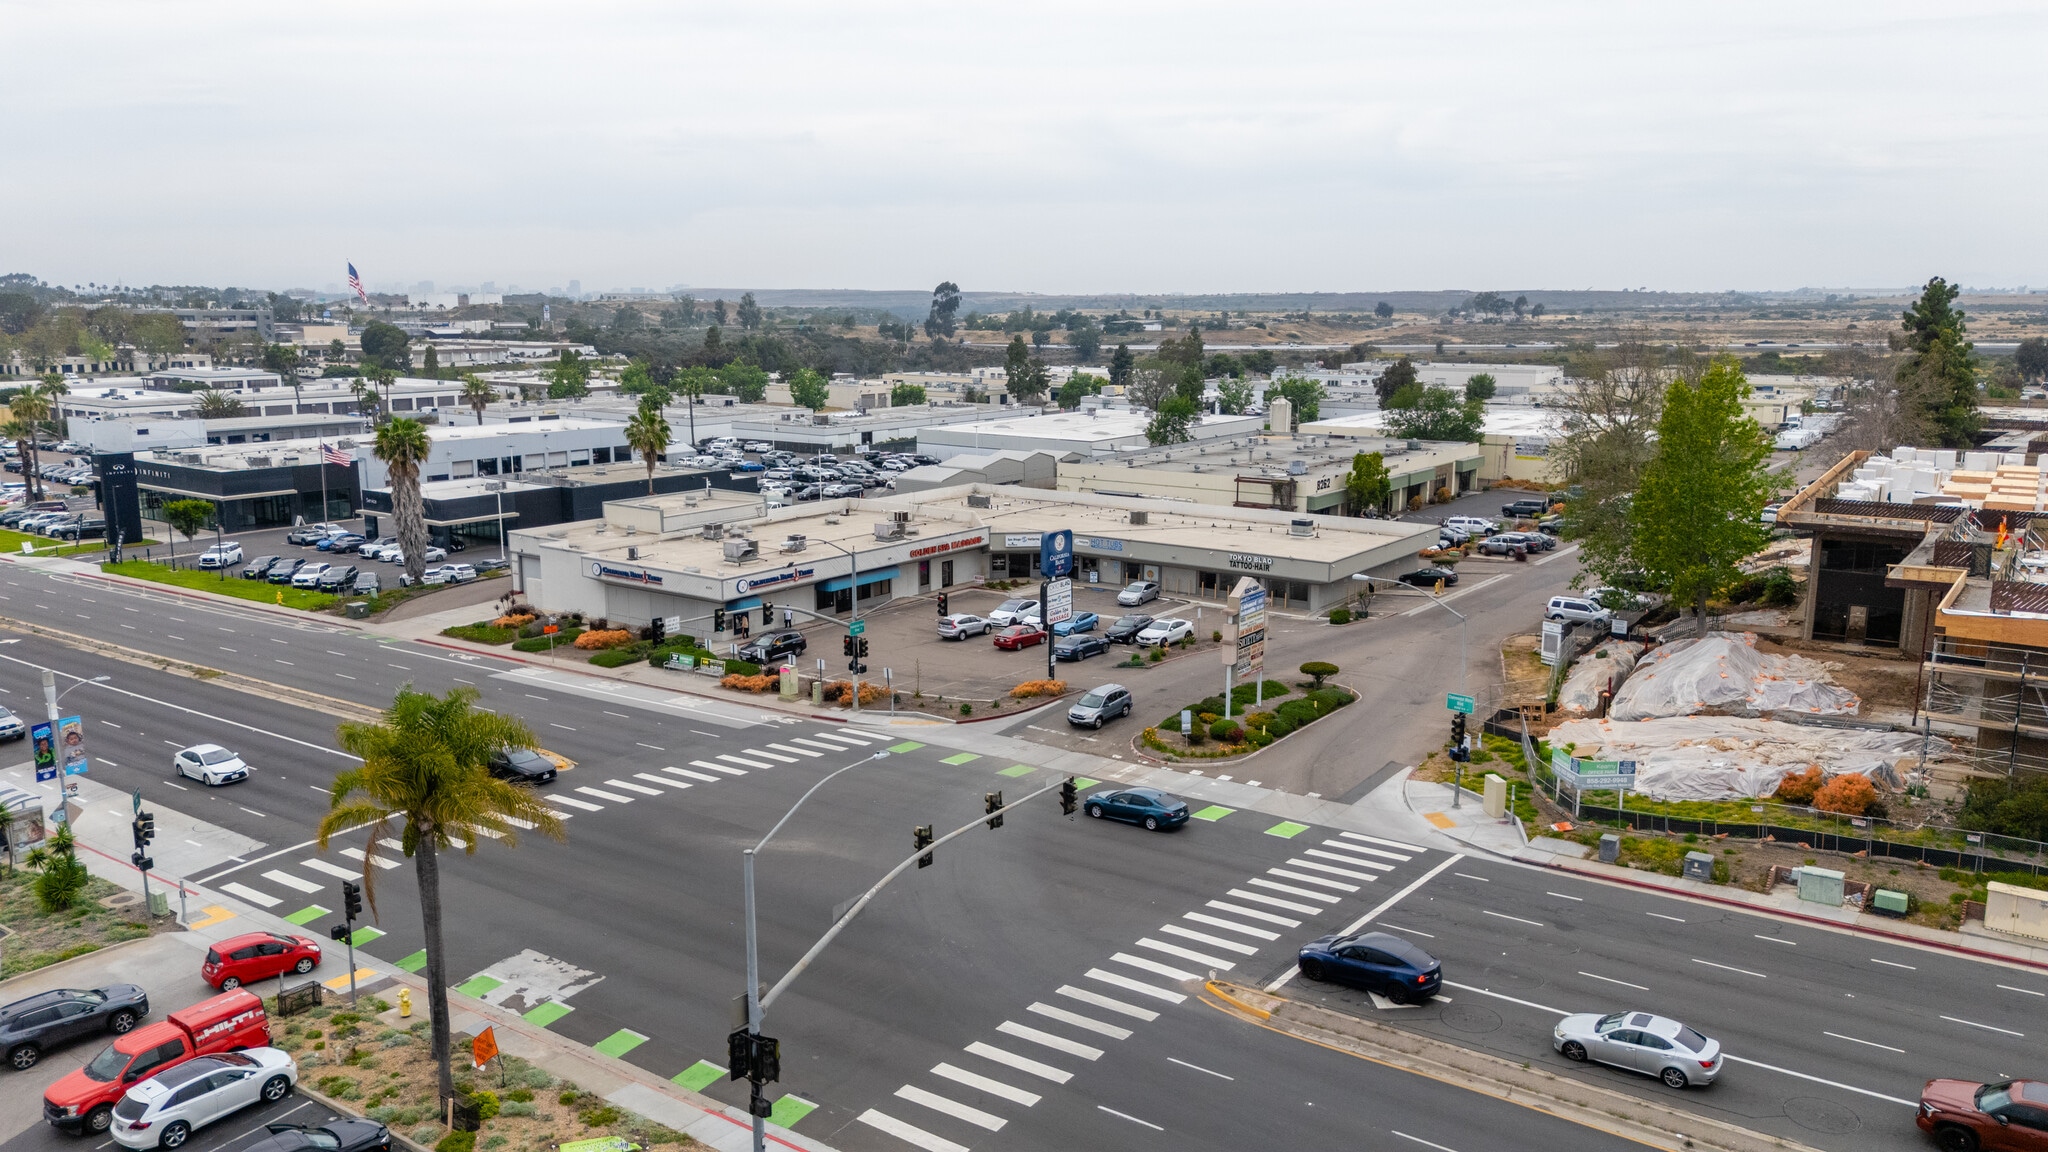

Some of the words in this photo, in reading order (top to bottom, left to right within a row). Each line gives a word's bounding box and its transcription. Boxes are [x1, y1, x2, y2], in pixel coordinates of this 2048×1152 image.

[140, 468, 171, 479] INFINITI
[1091, 538, 1104, 546] HOT
[1107, 539, 1122, 549] TUBS
[910, 546, 937, 558] GOLDEN
[938, 544, 950, 552] SPA
[1050, 552, 1070, 562] CALIFORNIA
[1230, 554, 1252, 562] TOKYO
[749, 576, 780, 587] CALIFORNIA
[780, 572, 794, 580] BANK
[1050, 613, 1070, 622] MASSAGE
[203, 1010, 254, 1037] HILTI
